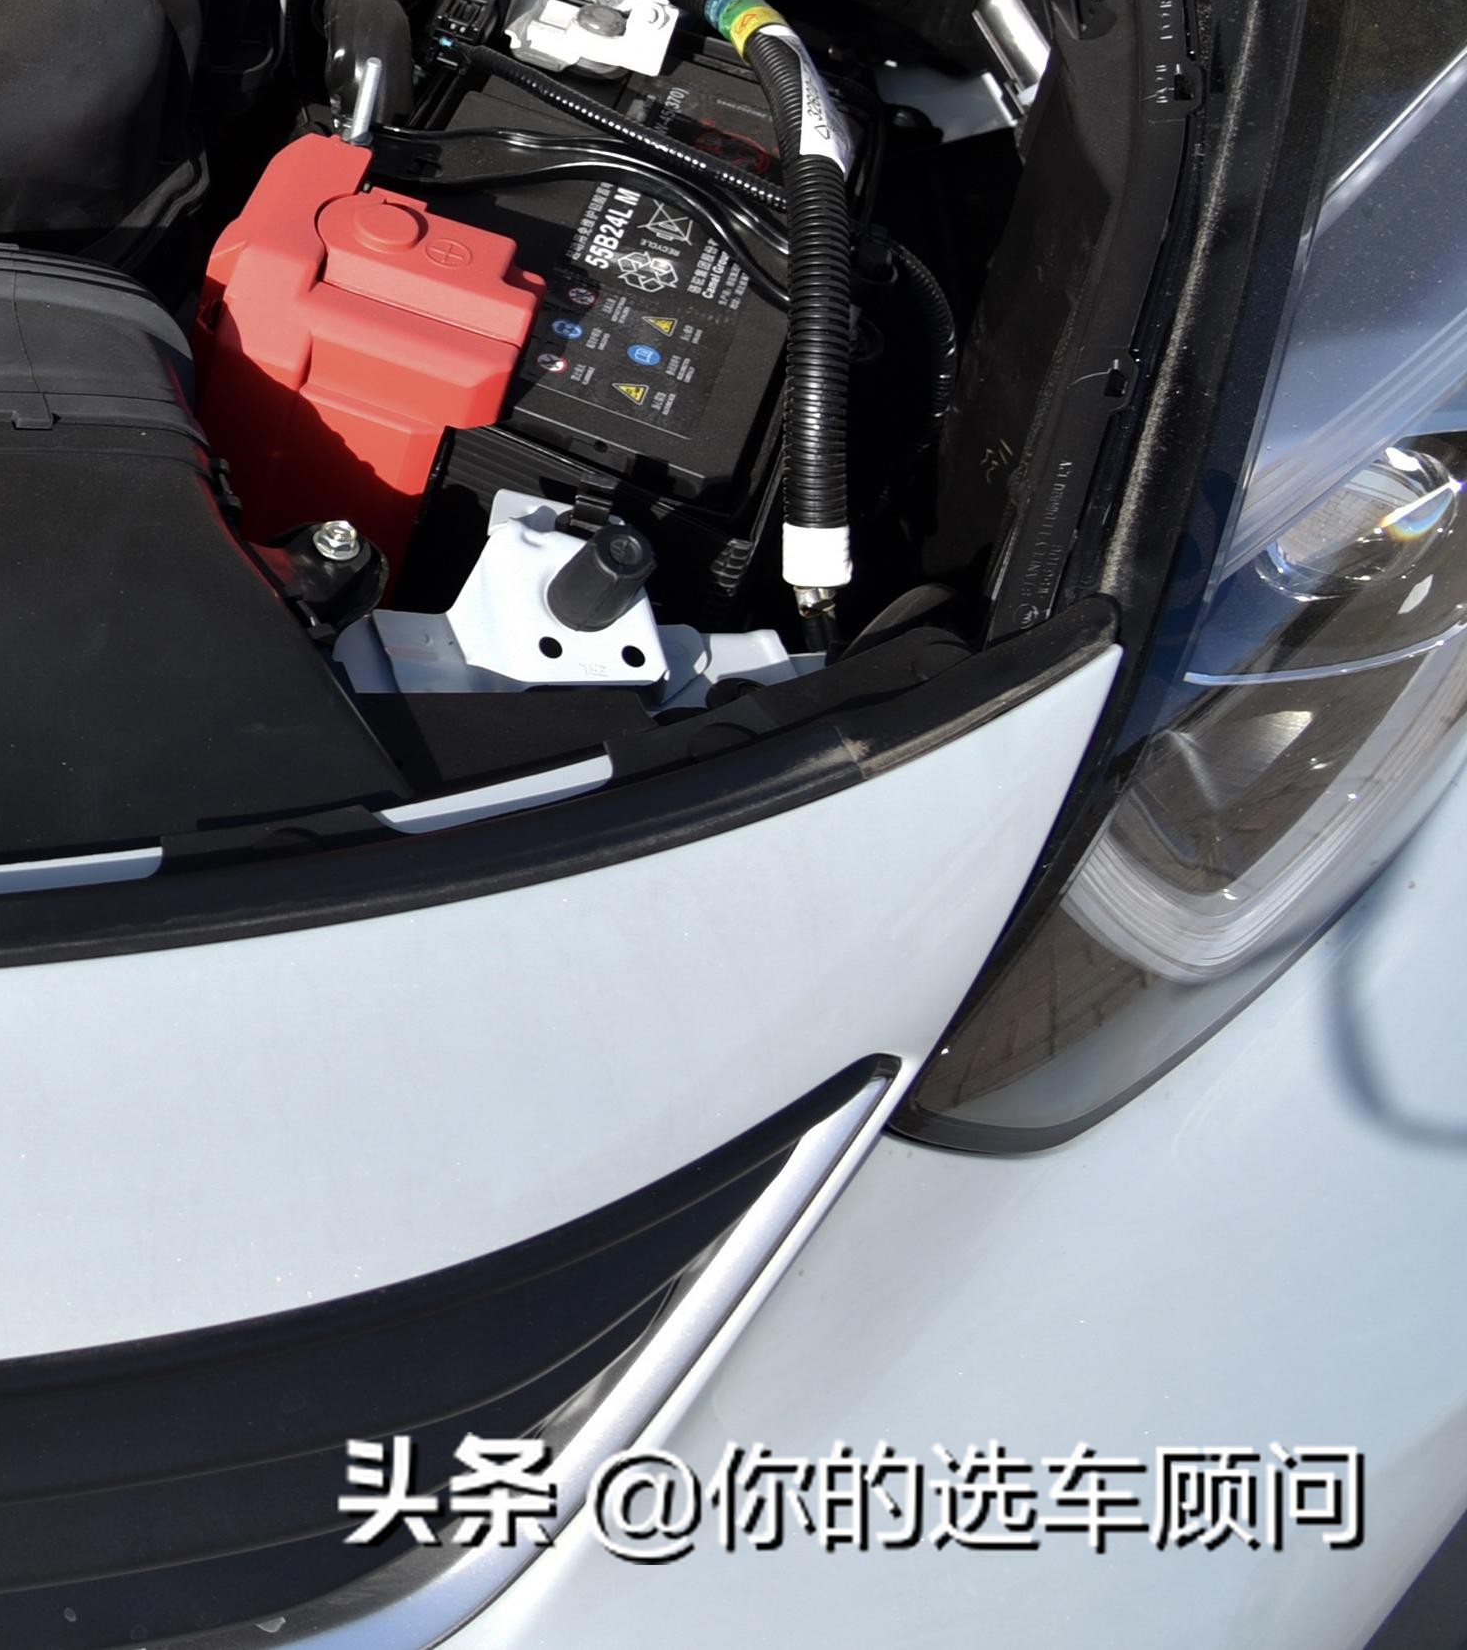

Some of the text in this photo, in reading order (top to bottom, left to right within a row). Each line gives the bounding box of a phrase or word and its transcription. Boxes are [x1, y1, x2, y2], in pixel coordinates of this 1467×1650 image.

[584, 204, 634, 270] 55B24L
[640, 237, 681, 258] RECYCLE
[701, 272, 721, 299] Camel
